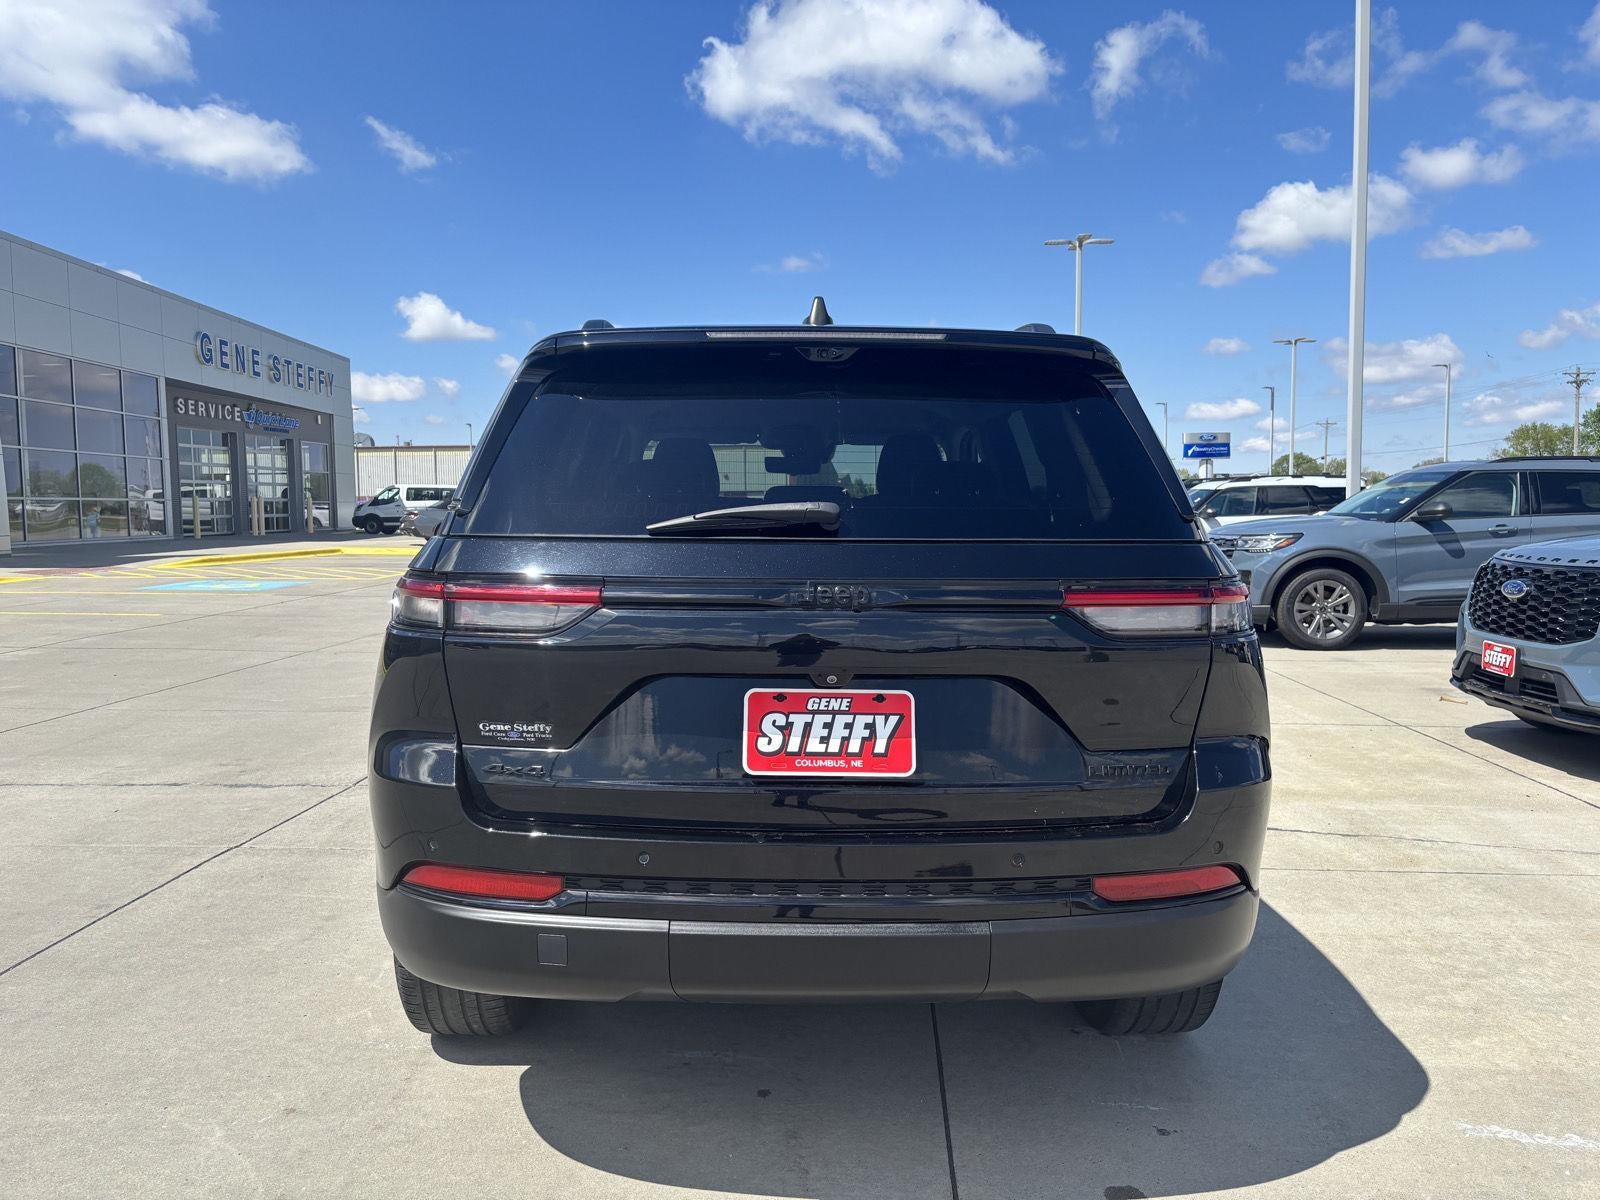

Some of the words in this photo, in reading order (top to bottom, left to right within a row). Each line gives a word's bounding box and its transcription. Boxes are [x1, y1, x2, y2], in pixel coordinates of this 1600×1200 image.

[196, 331, 262, 379] GENE
[270, 353, 334, 396] STEFFY
[177, 398, 241, 422] SERVICE
[804, 580, 870, 612] Jeep
[1485, 649, 1512, 669] STEFFY
[806, 697, 852, 711] GENE
[479, 722, 511, 731] Gene
[513, 723, 552, 733] Steffy
[756, 711, 905, 757] STEFFY
[795, 759, 848, 768] COLUMBUS,
[851, 759, 864, 768] NE
